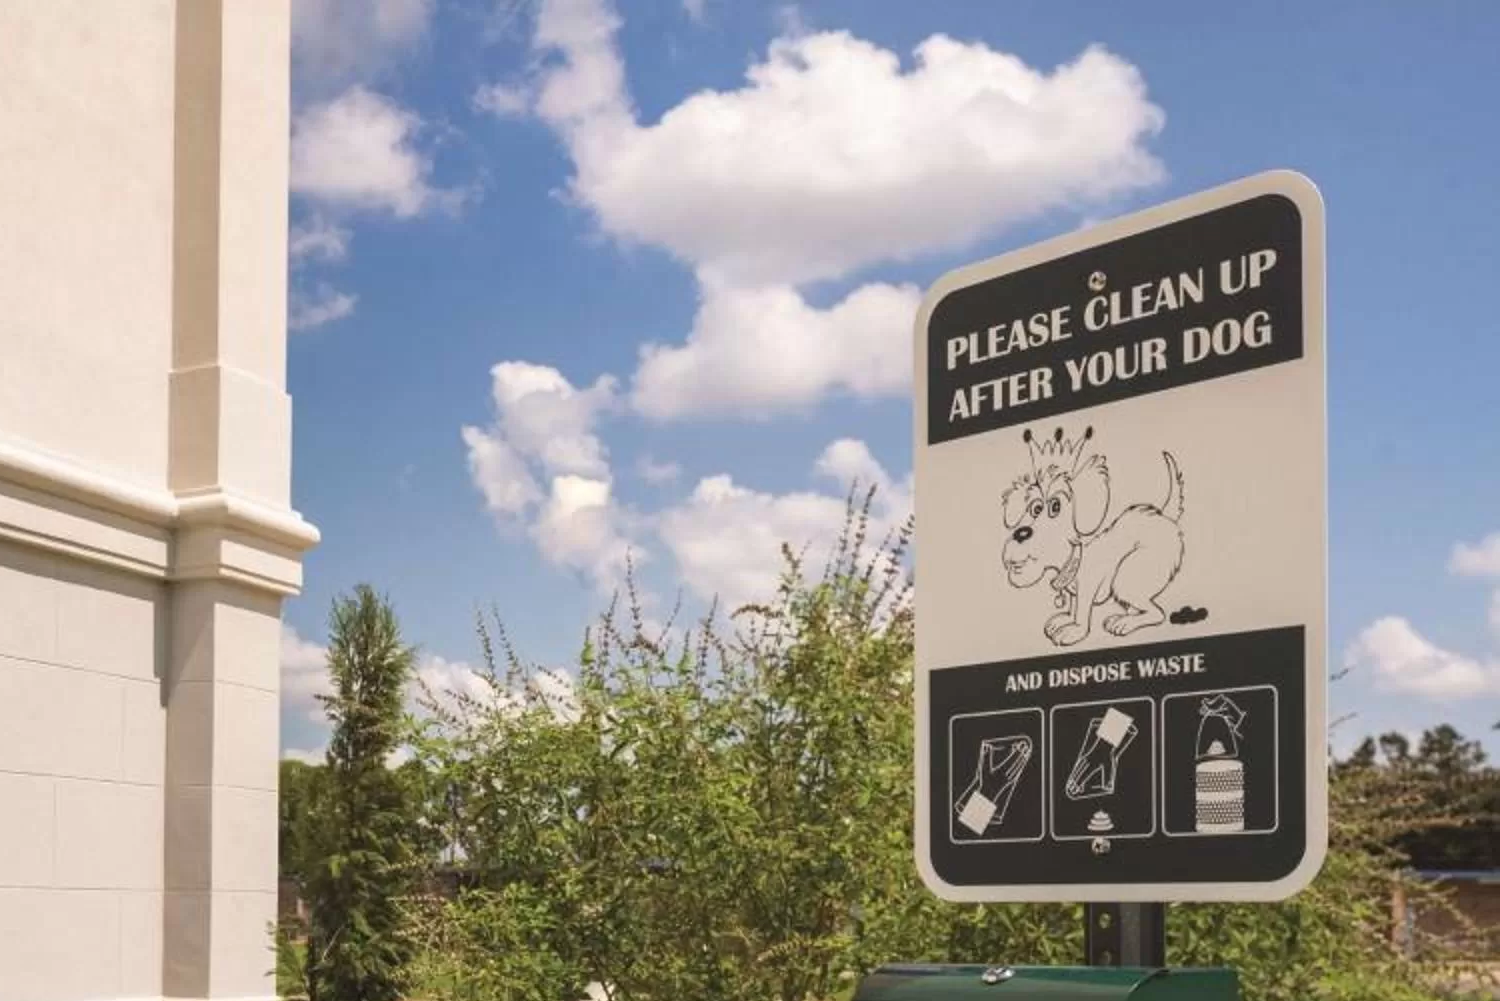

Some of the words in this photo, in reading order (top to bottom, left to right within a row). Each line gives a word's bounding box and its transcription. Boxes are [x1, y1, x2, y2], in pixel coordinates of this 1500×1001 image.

[946, 305, 1073, 371] PLEASE
[1084, 267, 1204, 332] CLEAN
[1219, 248, 1277, 296] UP
[948, 366, 1053, 423] AFTER
[1064, 337, 1167, 393] YOUR
[1183, 311, 1272, 364] DOG
[1005, 671, 1043, 693] AND
[1049, 661, 1131, 688] DISPOSE
[1137, 653, 1206, 678] WASTE
